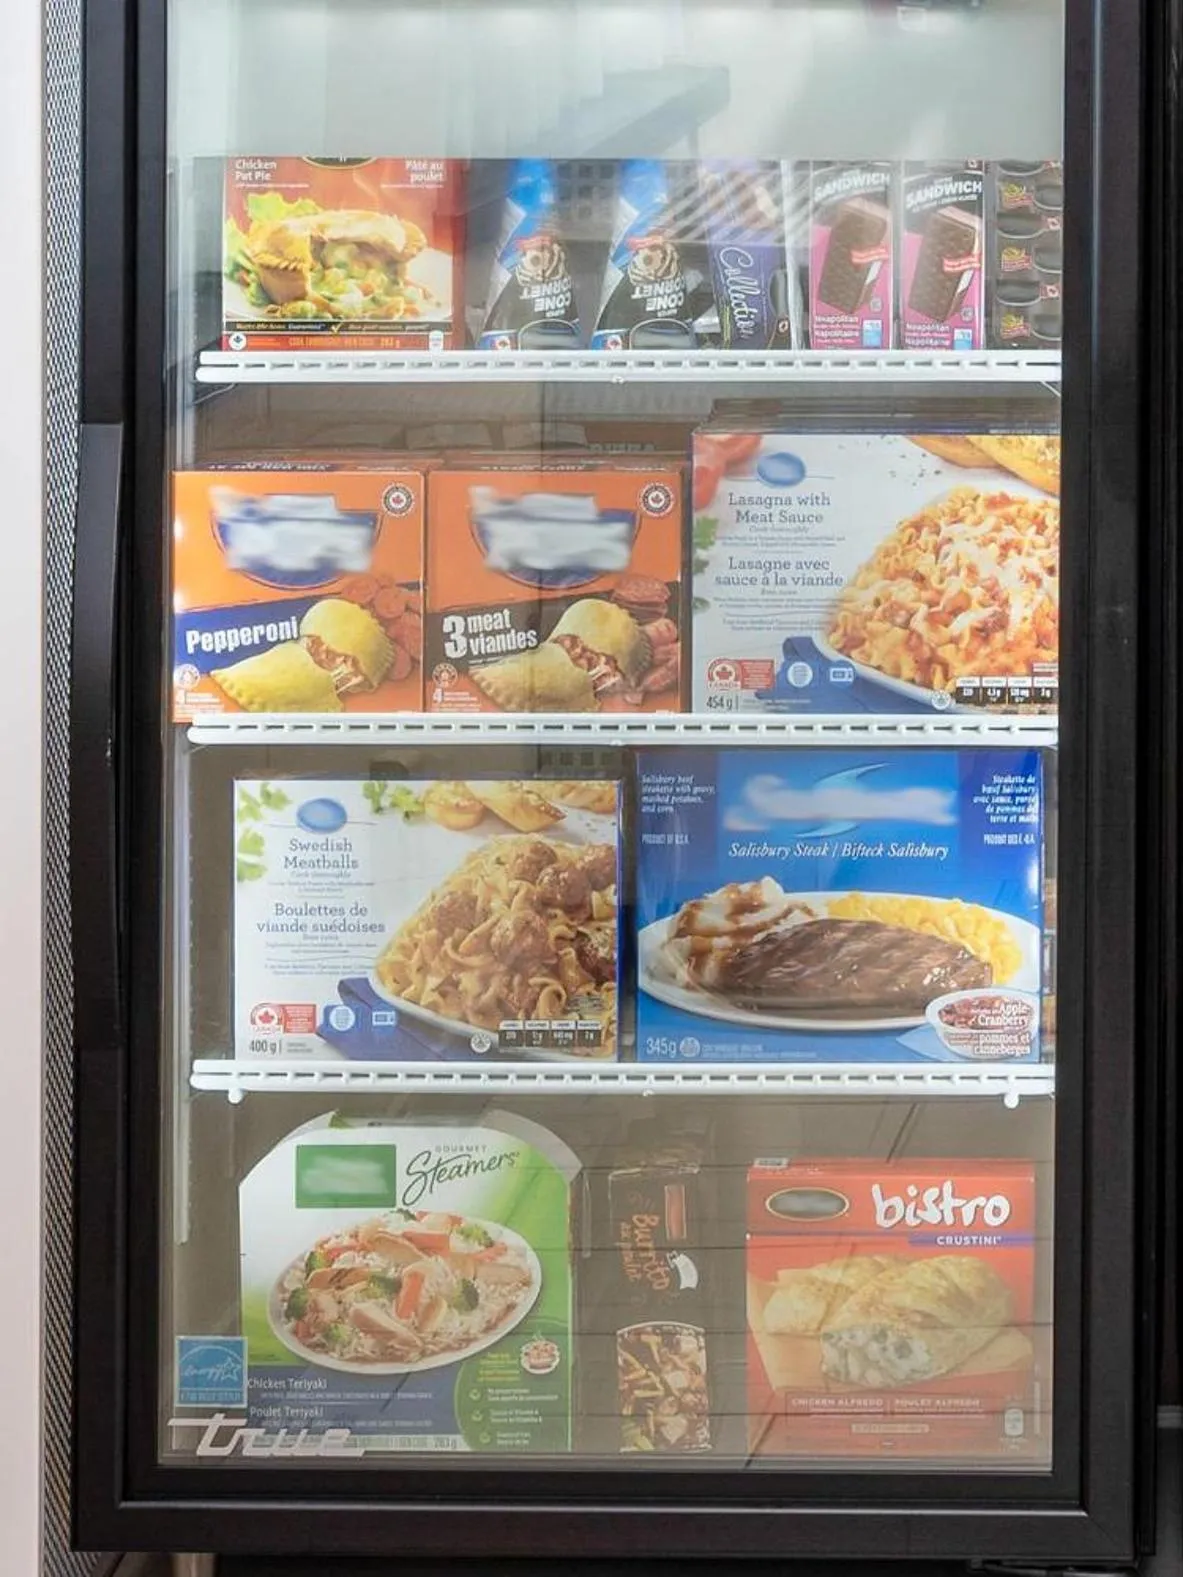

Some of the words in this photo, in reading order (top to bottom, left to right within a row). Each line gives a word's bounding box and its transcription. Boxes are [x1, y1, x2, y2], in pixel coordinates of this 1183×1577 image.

[235, 159, 277, 170] Chicken
[814, 172, 890, 203] SANDWICH
[905, 181, 982, 208] SANDWICH
[533, 291, 571, 313] CONE
[645, 290, 685, 312] CONE
[728, 492, 792, 509] Lasagna
[797, 491, 831, 506] with
[735, 510, 773, 524] Meat
[779, 510, 824, 524] Sauce
[728, 556, 792, 573] Lasagne
[795, 559, 830, 570] avec
[715, 574, 758, 586] sauce
[774, 571, 787, 586] la
[791, 571, 844, 586] viande
[185, 615, 299, 654] Pepperoni
[443, 614, 467, 659] 3
[467, 608, 511, 634] meat
[469, 628, 539, 656] viandes
[706, 695, 725, 709] 454
[288, 838, 353, 852] Swedish
[728, 842, 791, 860] Salisbury
[793, 842, 830, 857] Steak
[841, 842, 883, 860] Bifteck
[887, 842, 949, 861] Salisbury
[283, 855, 360, 870] Meatballs
[274, 902, 346, 917] Boulettes
[349, 902, 368, 917] de
[256, 918, 308, 933] viande
[312, 917, 386, 933] suédoises
[249, 1039, 268, 1052] 400
[435, 1144, 488, 1153] GOURMET
[402, 1150, 518, 1206] Steamers
[871, 1180, 1011, 1229] bistro
[937, 1235, 999, 1246] CRUSTINI
[632, 1213, 671, 1290] Burrito
[248, 1378, 286, 1390] Chicken
[288, 1377, 328, 1391] Teriyaki
[250, 1406, 282, 1418] Poulet
[284, 1405, 324, 1419] Teriyaki
